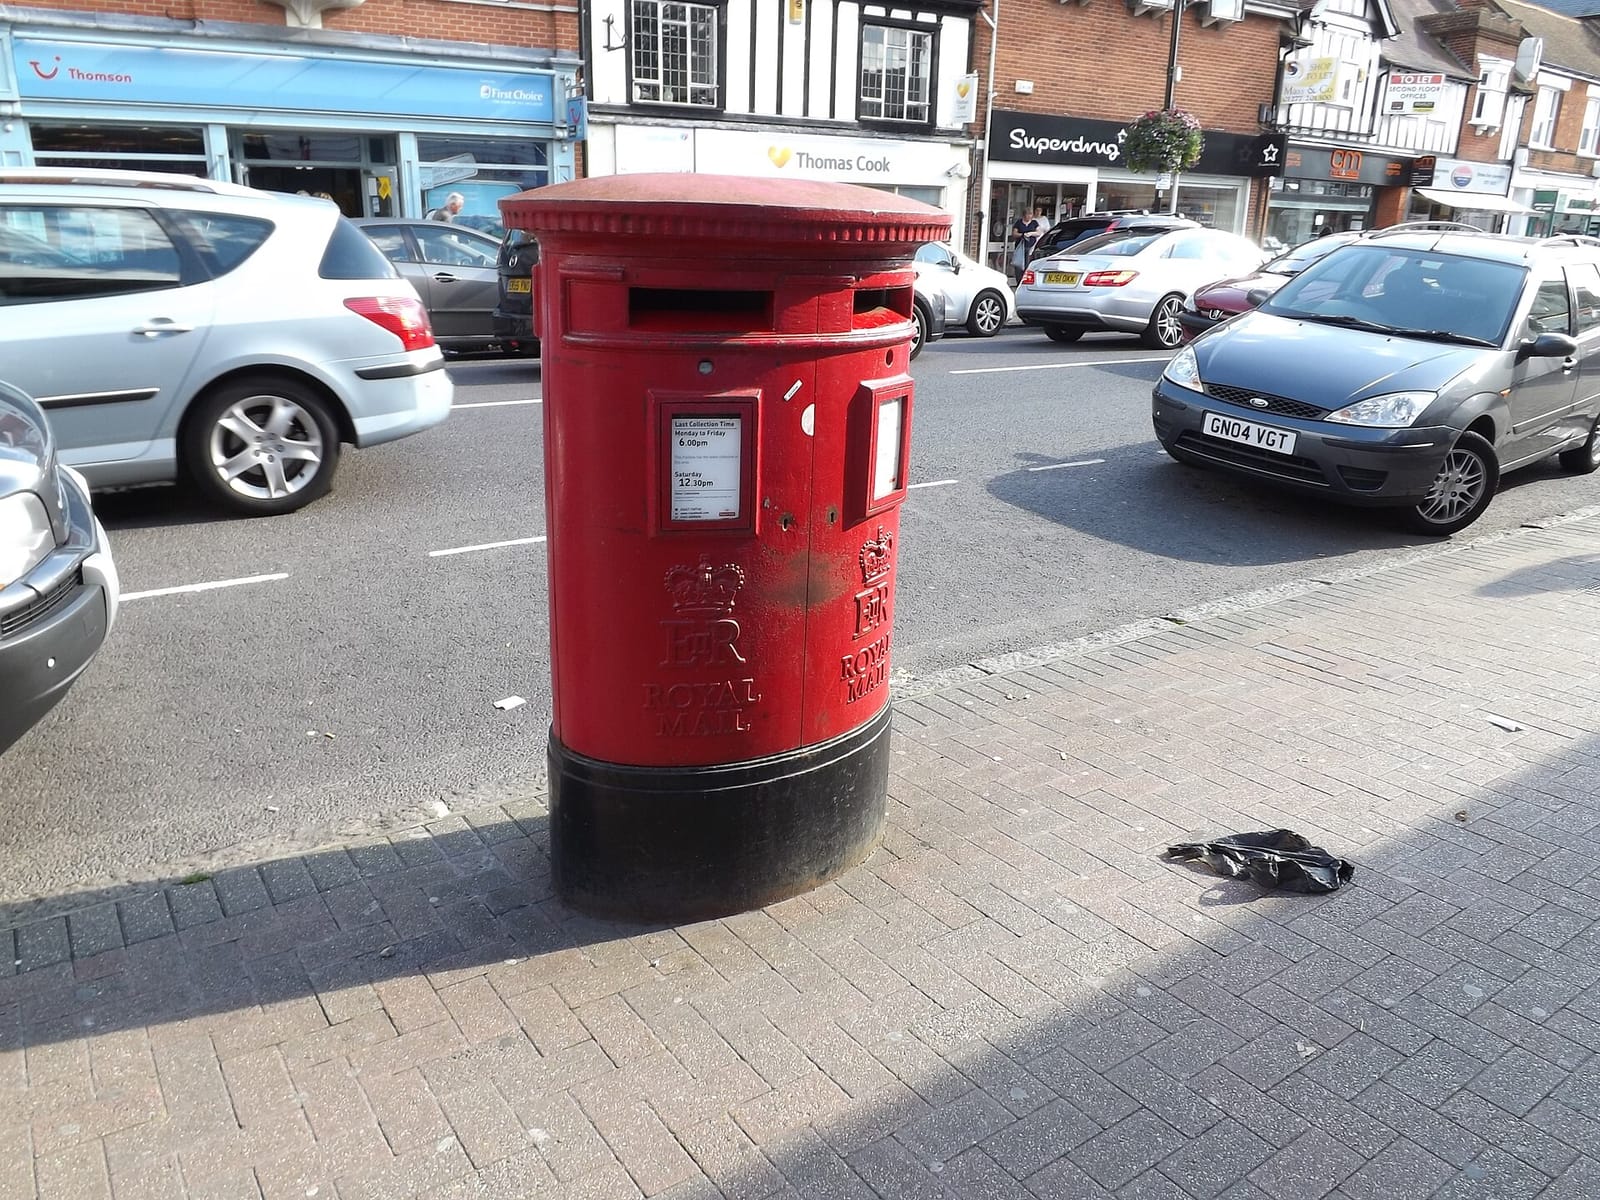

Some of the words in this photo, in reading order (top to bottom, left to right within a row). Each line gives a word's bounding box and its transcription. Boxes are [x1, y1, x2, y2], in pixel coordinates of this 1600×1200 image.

[68, 68, 132, 83] Thomson
[1400, 75, 1415, 84] TO
[1416, 75, 1433, 84] LET
[491, 88, 512, 100] First
[513, 89, 544, 101] Choice
[1009, 128, 1121, 161] Superdrug
[796, 152, 853, 170] Thomas
[856, 155, 890, 172] Cook
[1331, 150, 1363, 170] cm
[679, 437, 708, 447] 6.00pm
[1211, 418, 1250, 440] GN04
[1257, 427, 1288, 449] VGT
[679, 478, 714, 487] 12.30pm
[840, 632, 891, 681] ROYAL
[846, 660, 888, 705] MAIL
[641, 678, 762, 708] ROYAL
[654, 708, 751, 737] MAIL
